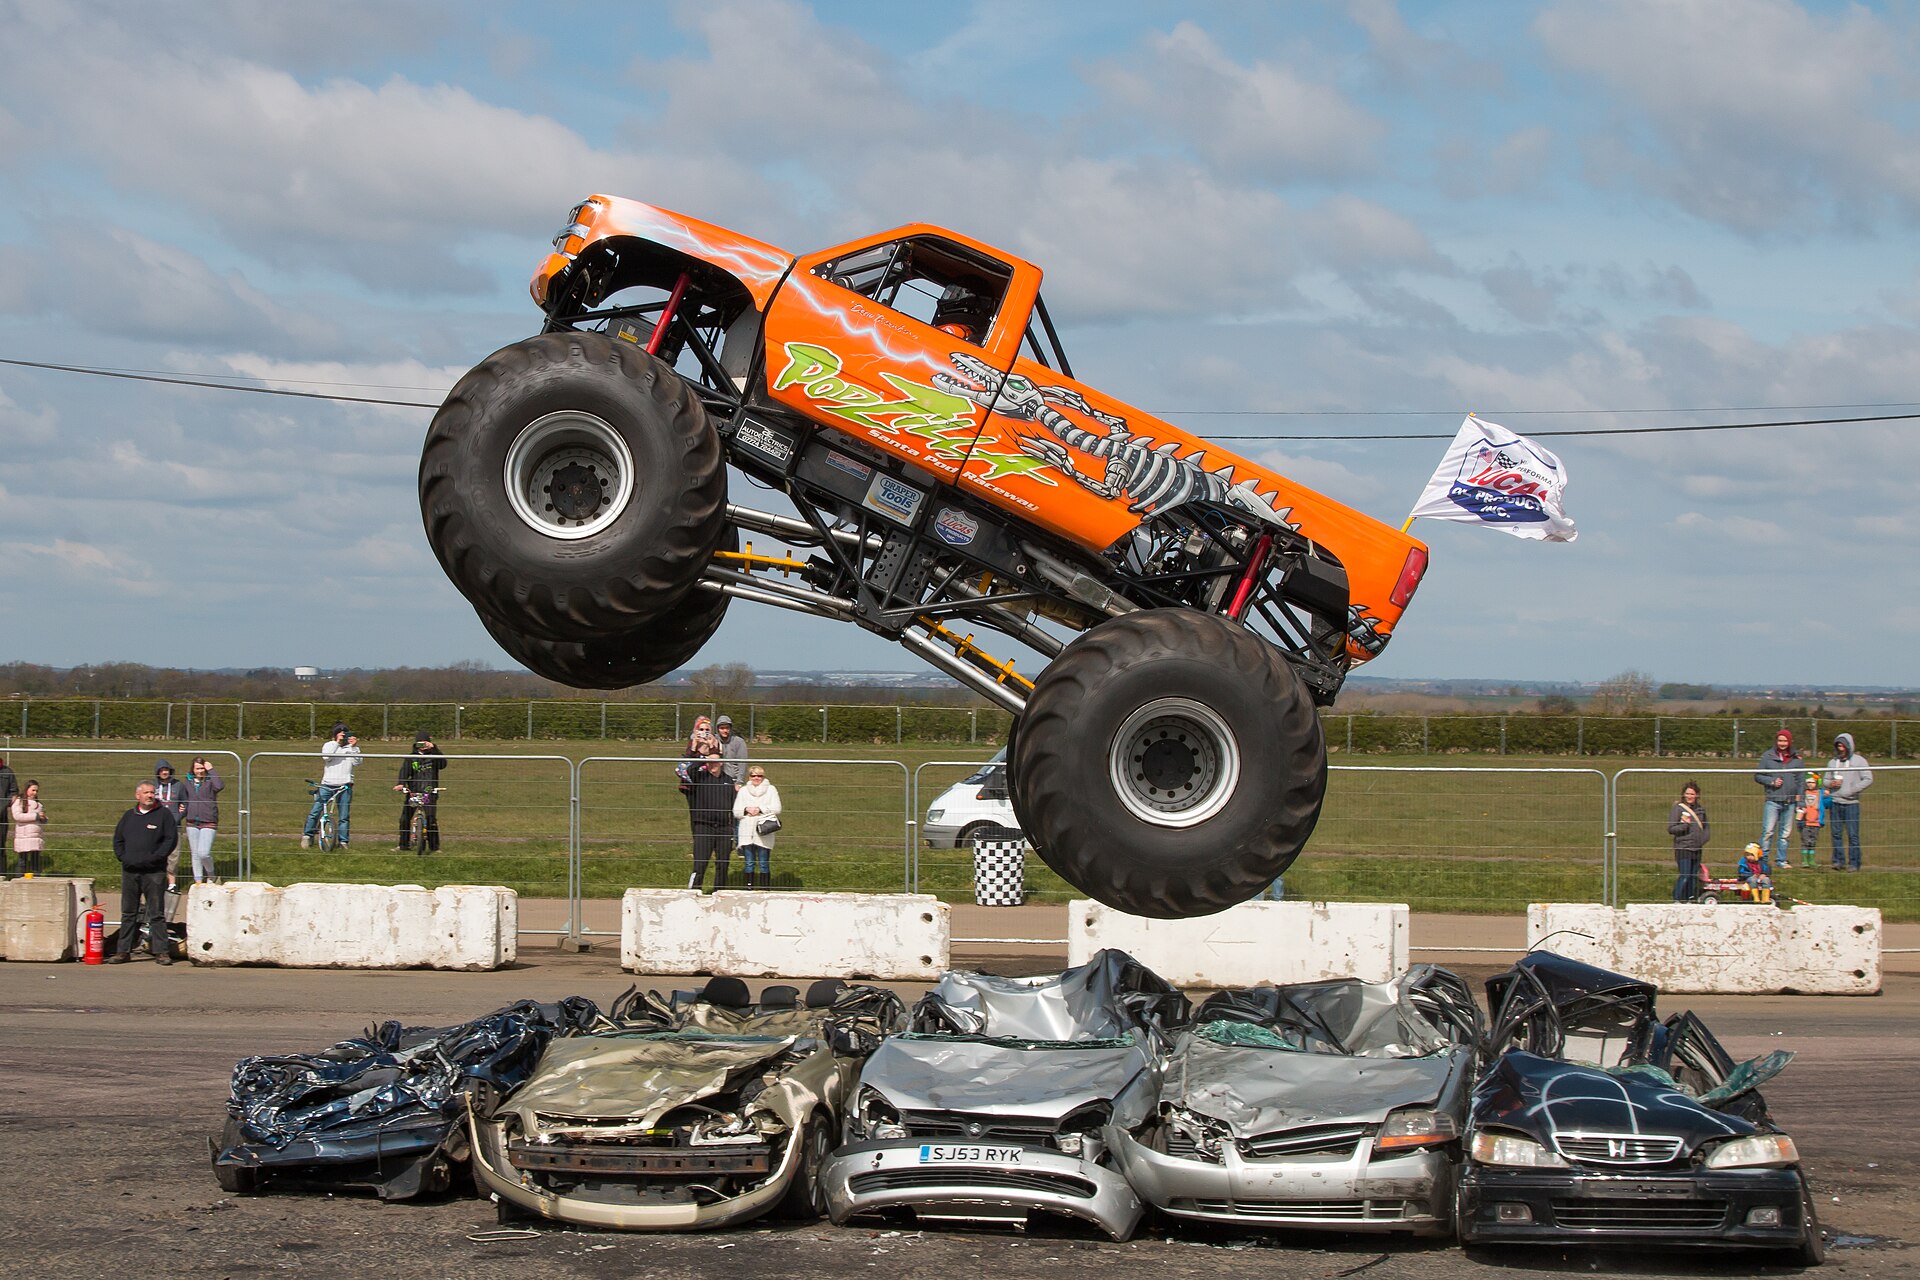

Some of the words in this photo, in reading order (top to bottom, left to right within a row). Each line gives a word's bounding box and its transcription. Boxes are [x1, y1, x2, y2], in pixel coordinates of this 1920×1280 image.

[867, 429, 920, 457] Santa
[923, 455, 960, 475] Pod
[962, 470, 1040, 512] Raceway
[1516, 466, 1553, 488] PERFORMA
[881, 488, 913, 508] Tools
[884, 479, 917, 500] DRAPER
[1475, 489, 1546, 512] PRODUCT
[1480, 505, 1511, 518] INC.
[941, 518, 974, 535] LUCAS
[933, 1147, 980, 1160] SJ53
[985, 1148, 1021, 1162] RYK
